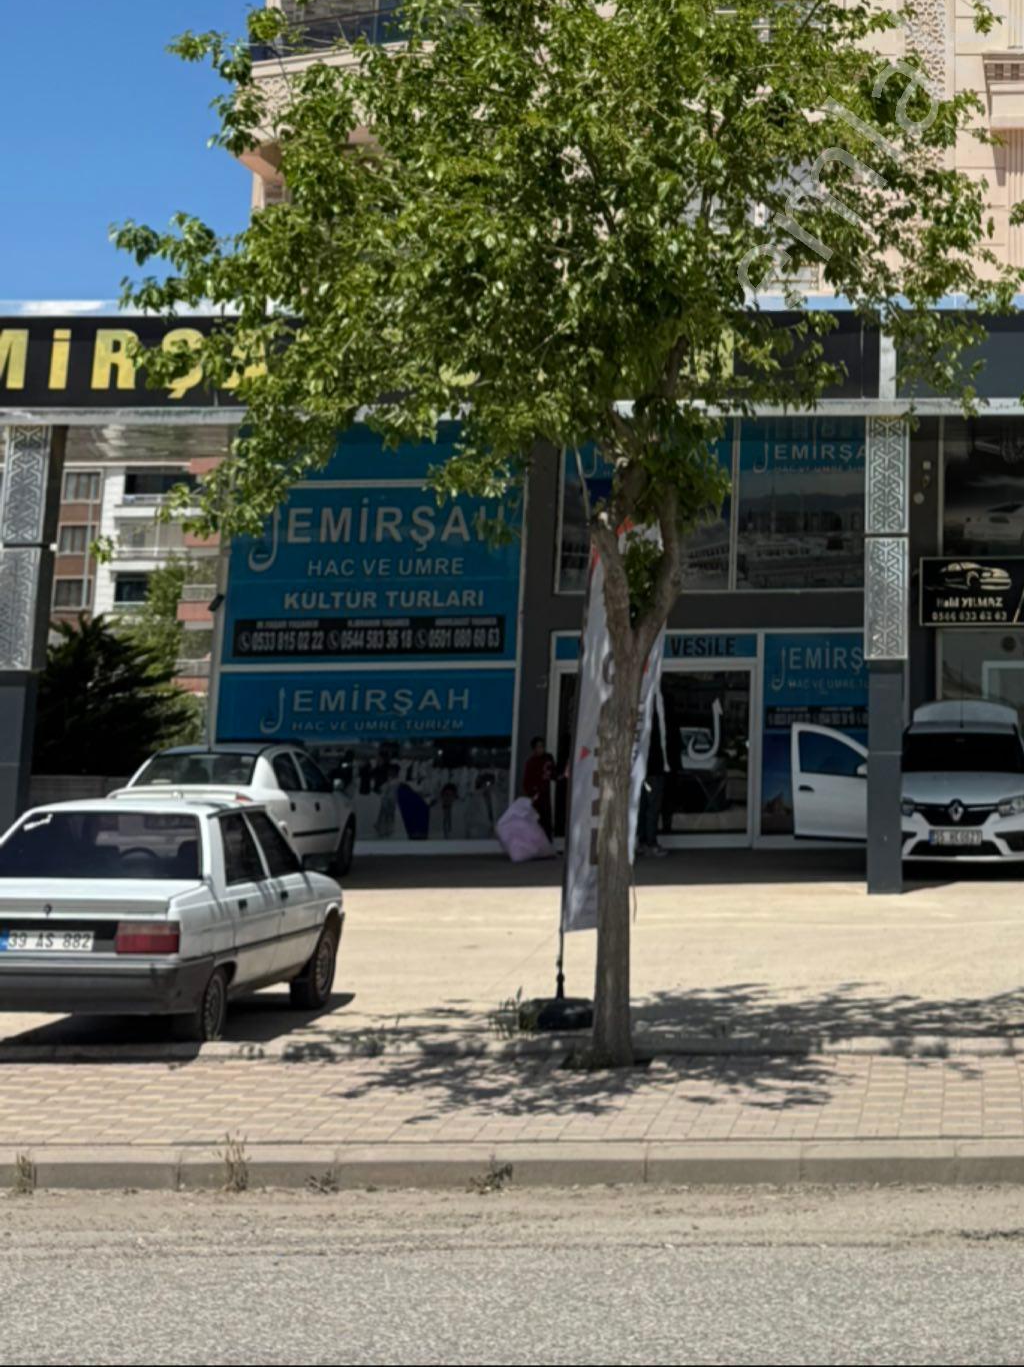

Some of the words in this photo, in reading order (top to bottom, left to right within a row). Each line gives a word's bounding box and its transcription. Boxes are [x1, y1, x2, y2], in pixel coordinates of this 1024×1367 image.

[308, 559, 355, 577] HAC
[363, 558, 392, 576] VE
[399, 557, 465, 576] UMRE
[386, 589, 485, 608] TURLARI
[293, 683, 470, 717] EMİRŞAH
[8, 932, 27, 948] 39
[35, 933, 54, 948] AS
[62, 933, 92, 948] 882
